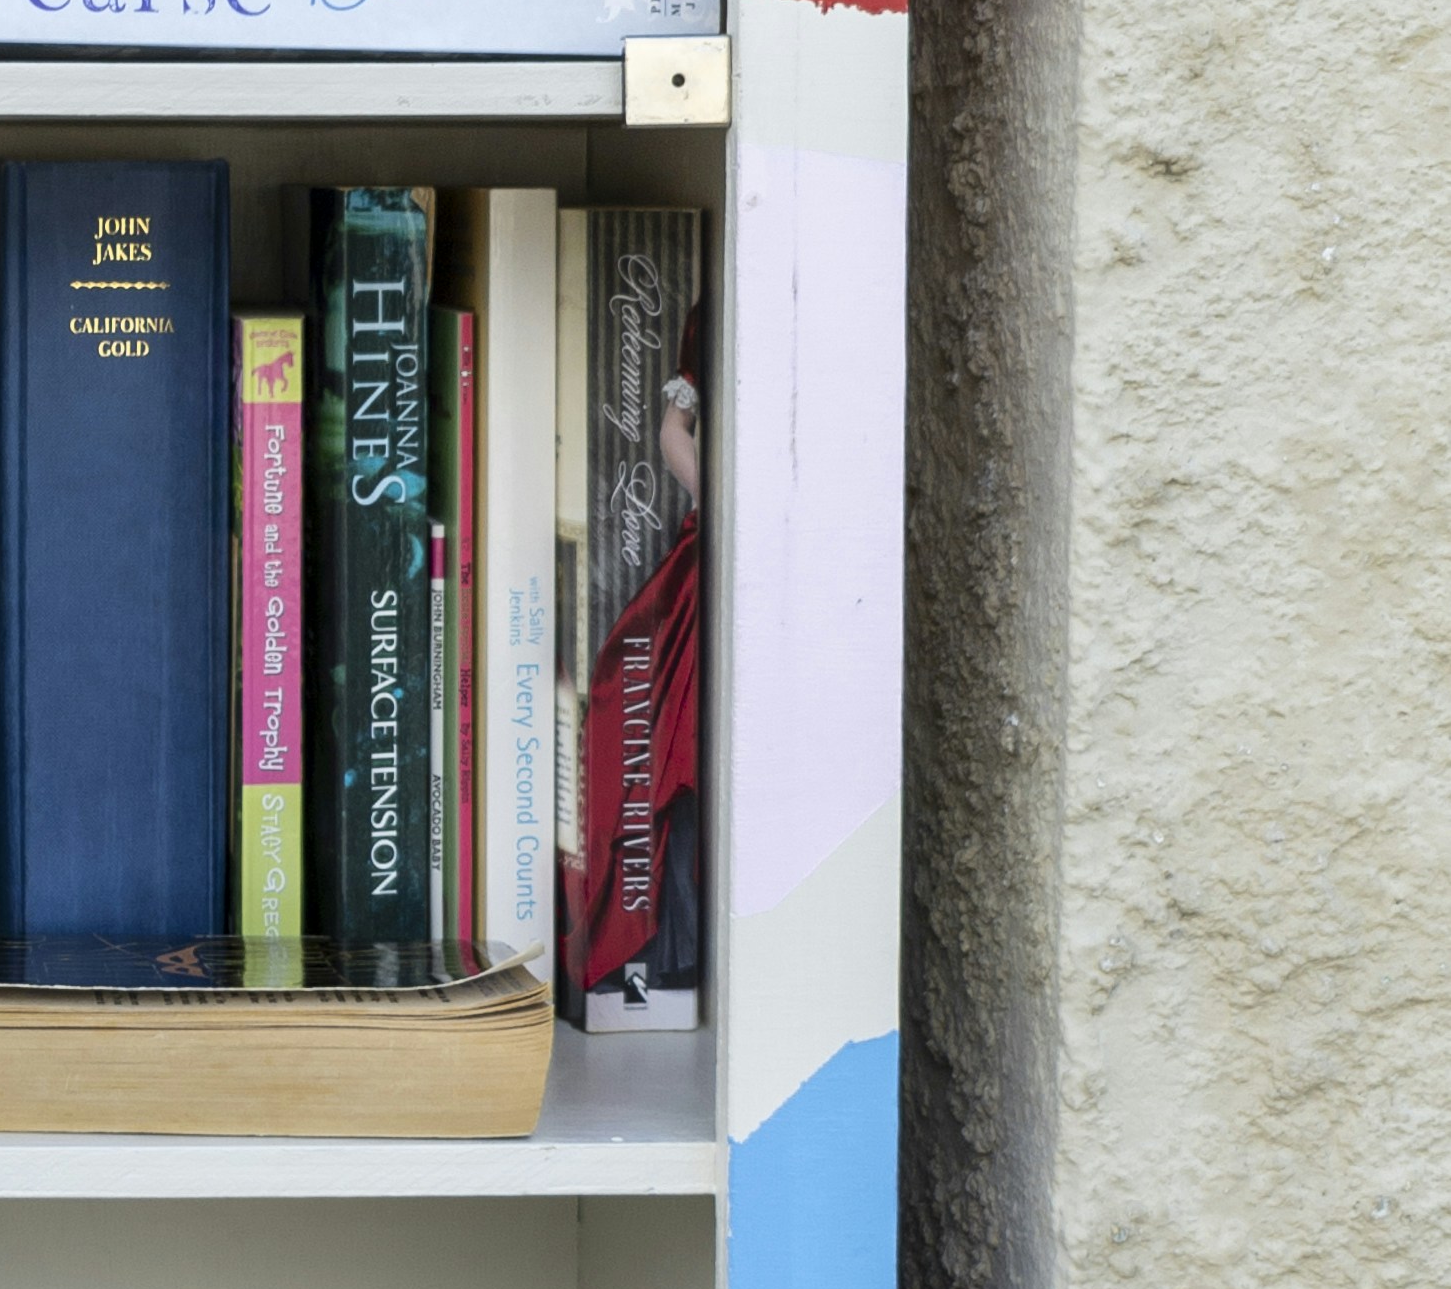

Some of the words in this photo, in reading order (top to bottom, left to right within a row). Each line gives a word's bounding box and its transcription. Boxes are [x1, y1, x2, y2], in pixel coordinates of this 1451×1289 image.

[92, 242, 153, 266] JAKES
[94, 217, 151, 240] JOHN
[69, 317, 175, 335] CALIFORNIA
[98, 340, 150, 357] GOLD
[602, 253, 662, 443] Redeeming
[352, 279, 407, 506] HINES
[392, 342, 419, 470] JOANNA
[263, 424, 287, 515] Fortune
[264, 523, 283, 554] and
[610, 461, 662, 567] Love
[264, 560, 284, 588] the
[432, 589, 443, 622] JOHN
[460, 562, 470, 585] The
[529, 576, 539, 604] with
[263, 596, 287, 677] Golden
[509, 588, 521, 646] Jenkins
[527, 607, 546, 646] Sally
[370, 589, 398, 740] SURFACE
[432, 626, 443, 711] BURNINGHAM
[459, 669, 471, 708] Helper
[511, 663, 539, 728] Every
[259, 687, 284, 772] Trophy
[622, 636, 652, 788] FRANCINE
[431, 774, 442, 836] AVOCADO
[516, 738, 539, 825] Second
[370, 742, 398, 895] TENSION
[431, 838, 441, 871] BABY
[516, 836, 539, 921] Counts
[622, 798, 652, 912] RIVERS
